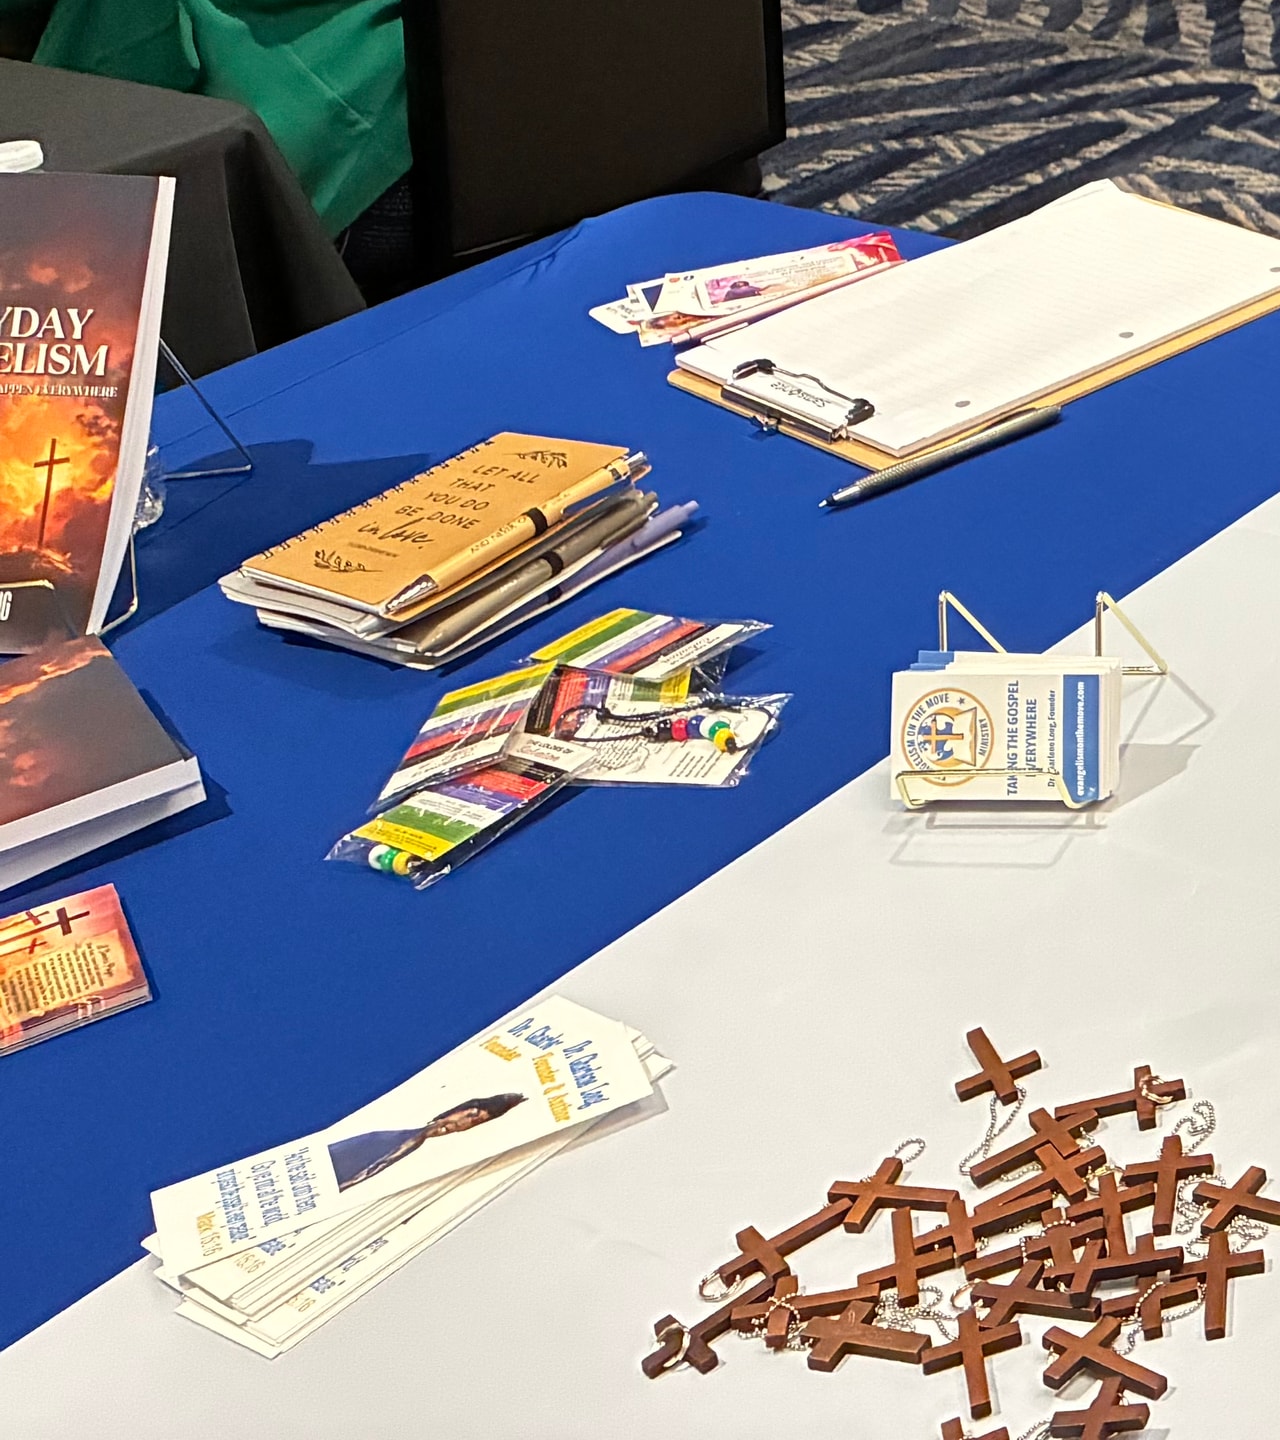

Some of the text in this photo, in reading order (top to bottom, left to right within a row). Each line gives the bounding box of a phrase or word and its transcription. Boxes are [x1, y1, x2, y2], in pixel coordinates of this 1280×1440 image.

[448, 477, 496, 492] THAT
[471, 464, 540, 484] LET ALL
[423, 490, 490, 511] YOU DO
[394, 504, 480, 529] BE DONE
[356, 520, 380, 535] in
[379, 516, 436, 550] love.
[907, 723, 917, 737] ON
[912, 706, 926, 723] THE
[925, 693, 949, 709] MOVE
[1047, 689, 1056, 720] Founder
[978, 718, 989, 757] MINISTRY
[1005, 679, 1019, 795] TAKNG THE GOSPEL
[1074, 681, 1086, 796] evangelismonthemove.com
[562, 1039, 593, 1059] Dr.
